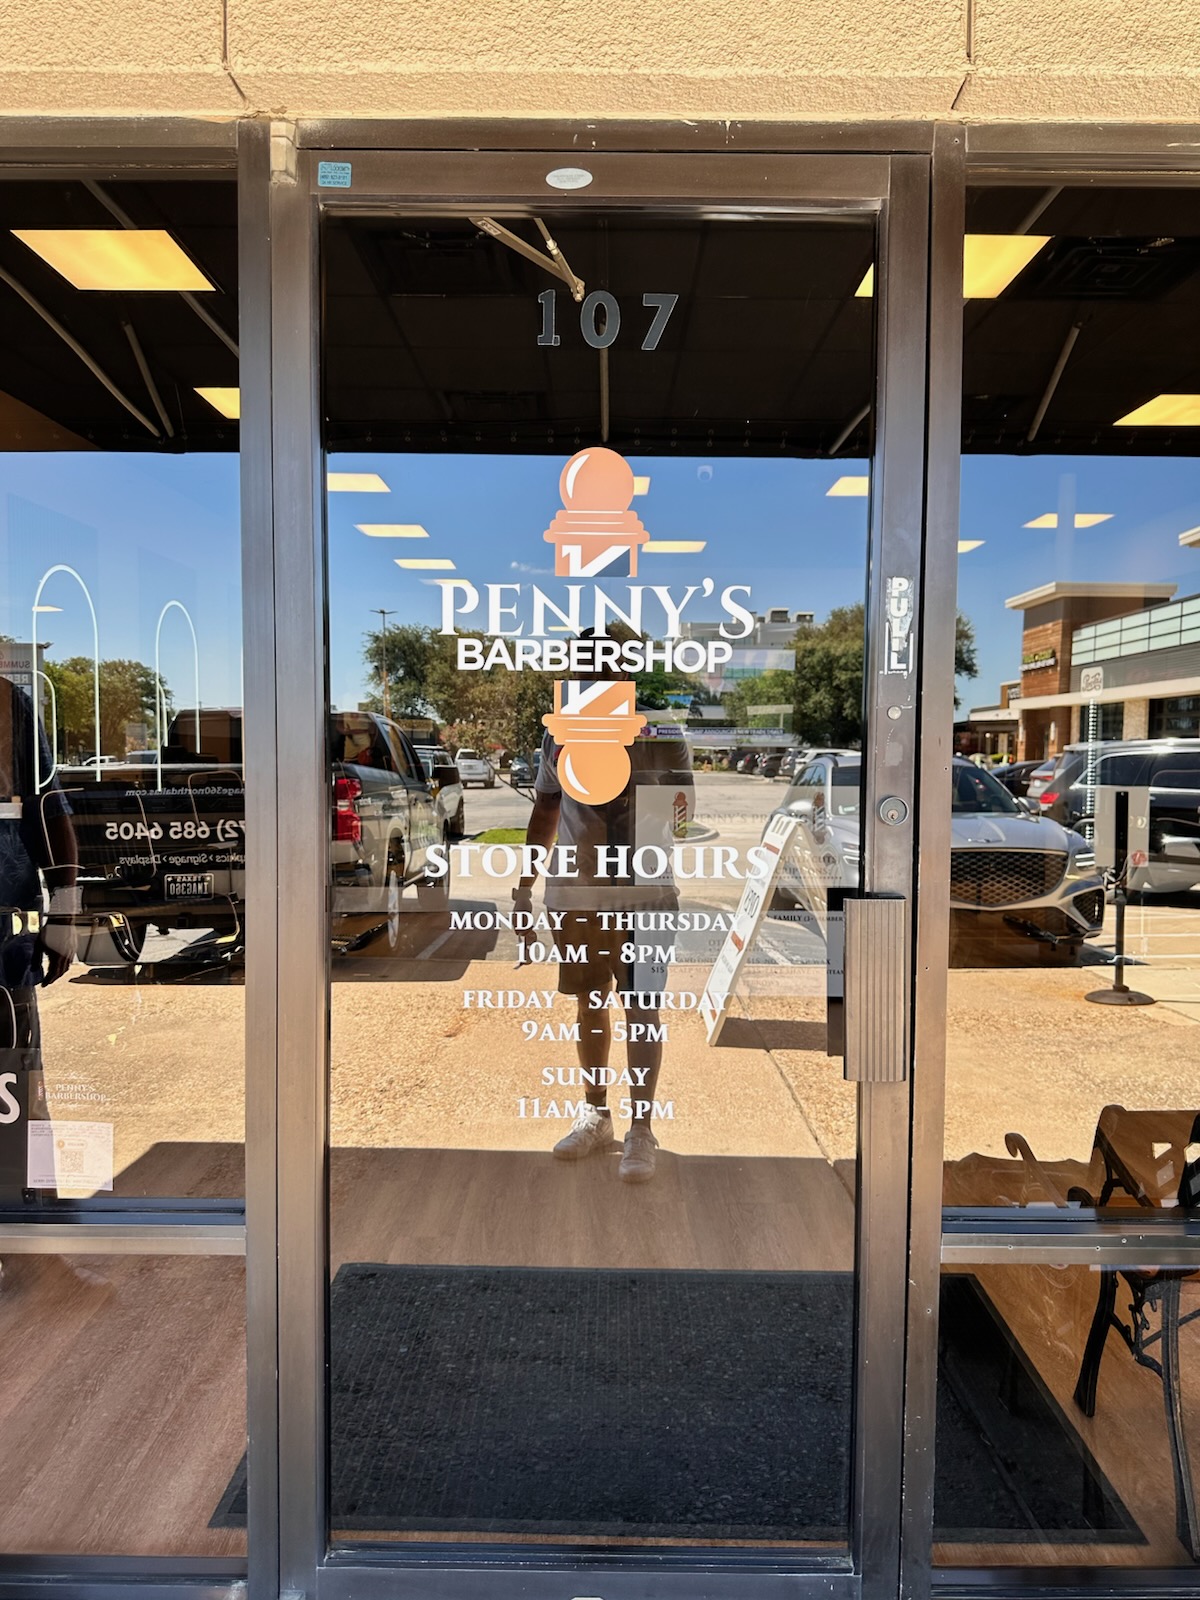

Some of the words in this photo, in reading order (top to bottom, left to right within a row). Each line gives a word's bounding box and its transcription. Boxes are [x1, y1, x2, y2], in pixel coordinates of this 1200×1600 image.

[538, 289, 679, 350] 107
[437, 577, 755, 639] PENNY'S
[457, 638, 733, 673] BARBERSHOP
[424, 844, 580, 879] STORE
[594, 844, 770, 880] HOURS
[449, 911, 568, 931] MONDAY
[597, 911, 741, 932] THURSDAY
[515, 942, 589, 964] 10AM
[620, 941, 677, 965] 8PM
[651, 966, 665, 974] $15
[463, 990, 558, 1009] FRIDAY
[588, 990, 730, 1011] SATURDAY
[522, 1021, 581, 1042] 9AM
[613, 1021, 670, 1043] 5PM
[541, 1066, 650, 1087] SUNDAY
[517, 1098, 587, 1120] 11AM
[619, 1098, 675, 1120] 5PM
